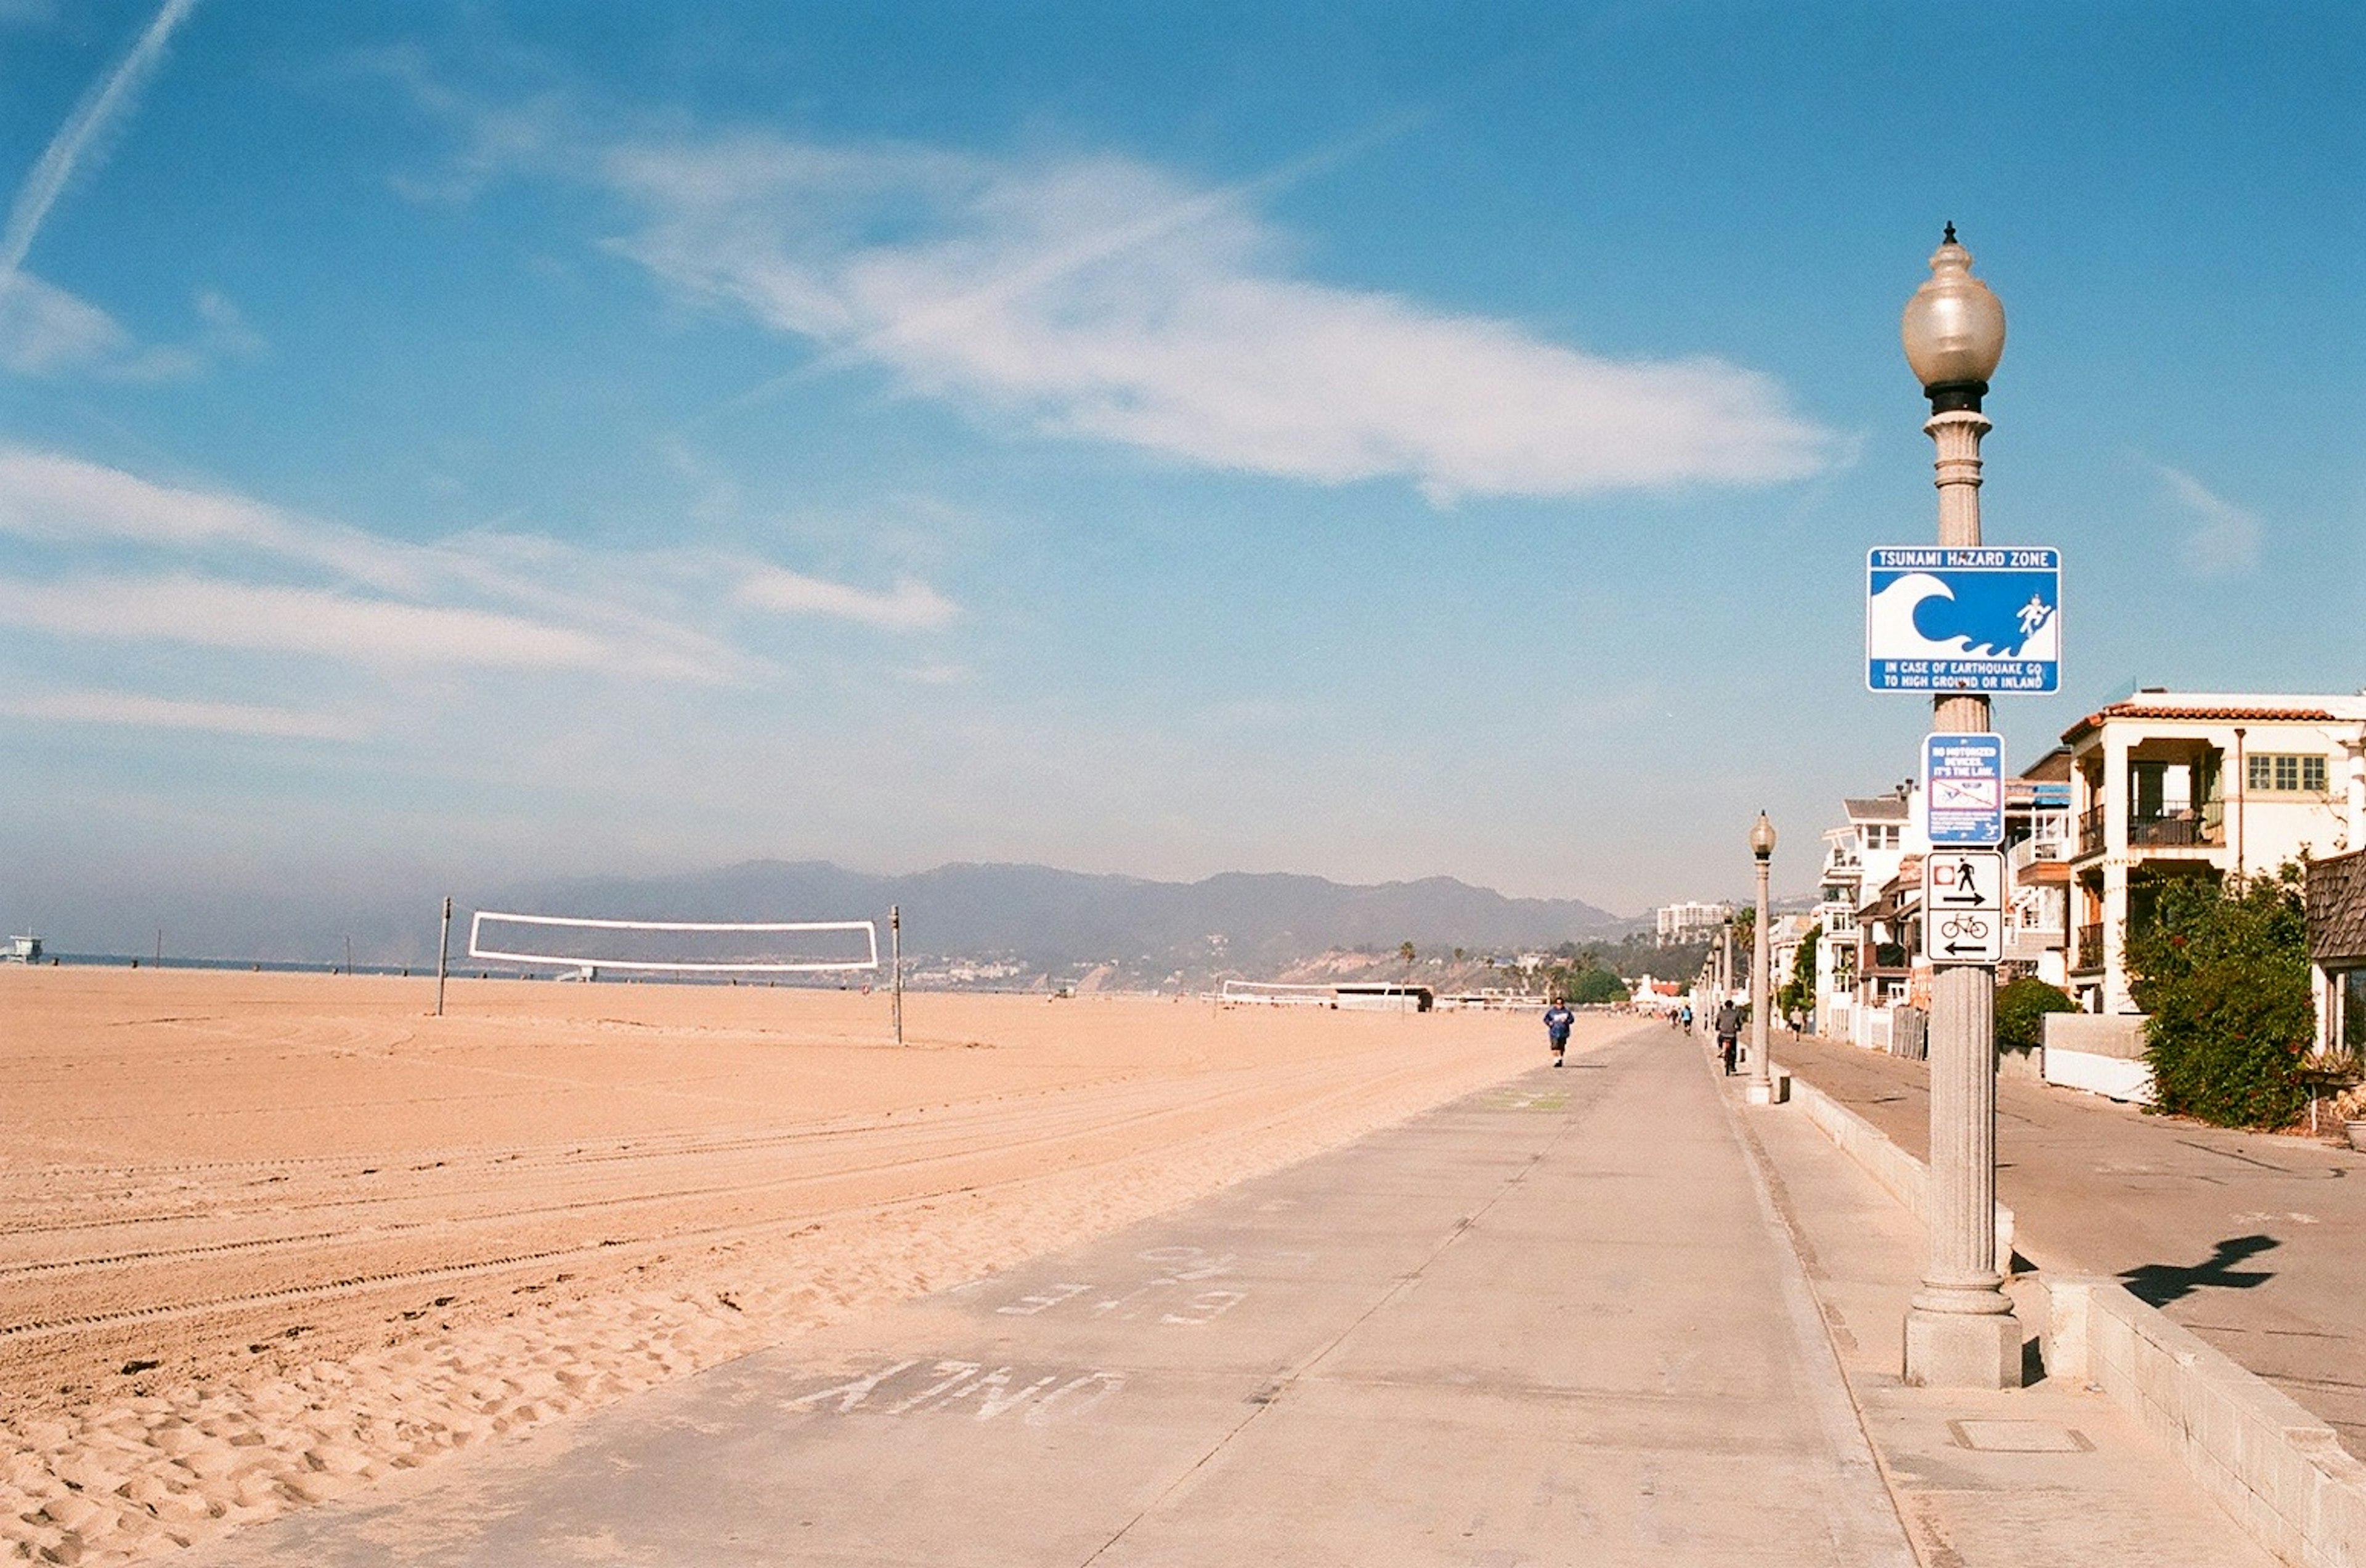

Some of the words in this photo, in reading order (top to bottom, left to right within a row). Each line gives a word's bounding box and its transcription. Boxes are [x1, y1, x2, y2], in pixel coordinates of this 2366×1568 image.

[1879, 551, 1941, 566] TSUNAMI
[1947, 551, 2005, 566] HAZARD
[2010, 552, 2049, 566] ZONE
[1885, 662, 1897, 673] IN
[1900, 662, 1929, 673] CASE
[1932, 662, 1946, 673] OF
[1951, 662, 2022, 674] EARTHQUAKE
[2026, 663, 2043, 675] GO
[1884, 675, 1898, 686] TO
[1901, 675, 1929, 687] HIGH
[1932, 675, 1978, 688] GROUND
[1982, 676, 1997, 688] OR
[2001, 676, 2043, 689] INLAND
[1946, 747, 1996, 757] MOTORIZED
[1953, 767, 1970, 776] THE
